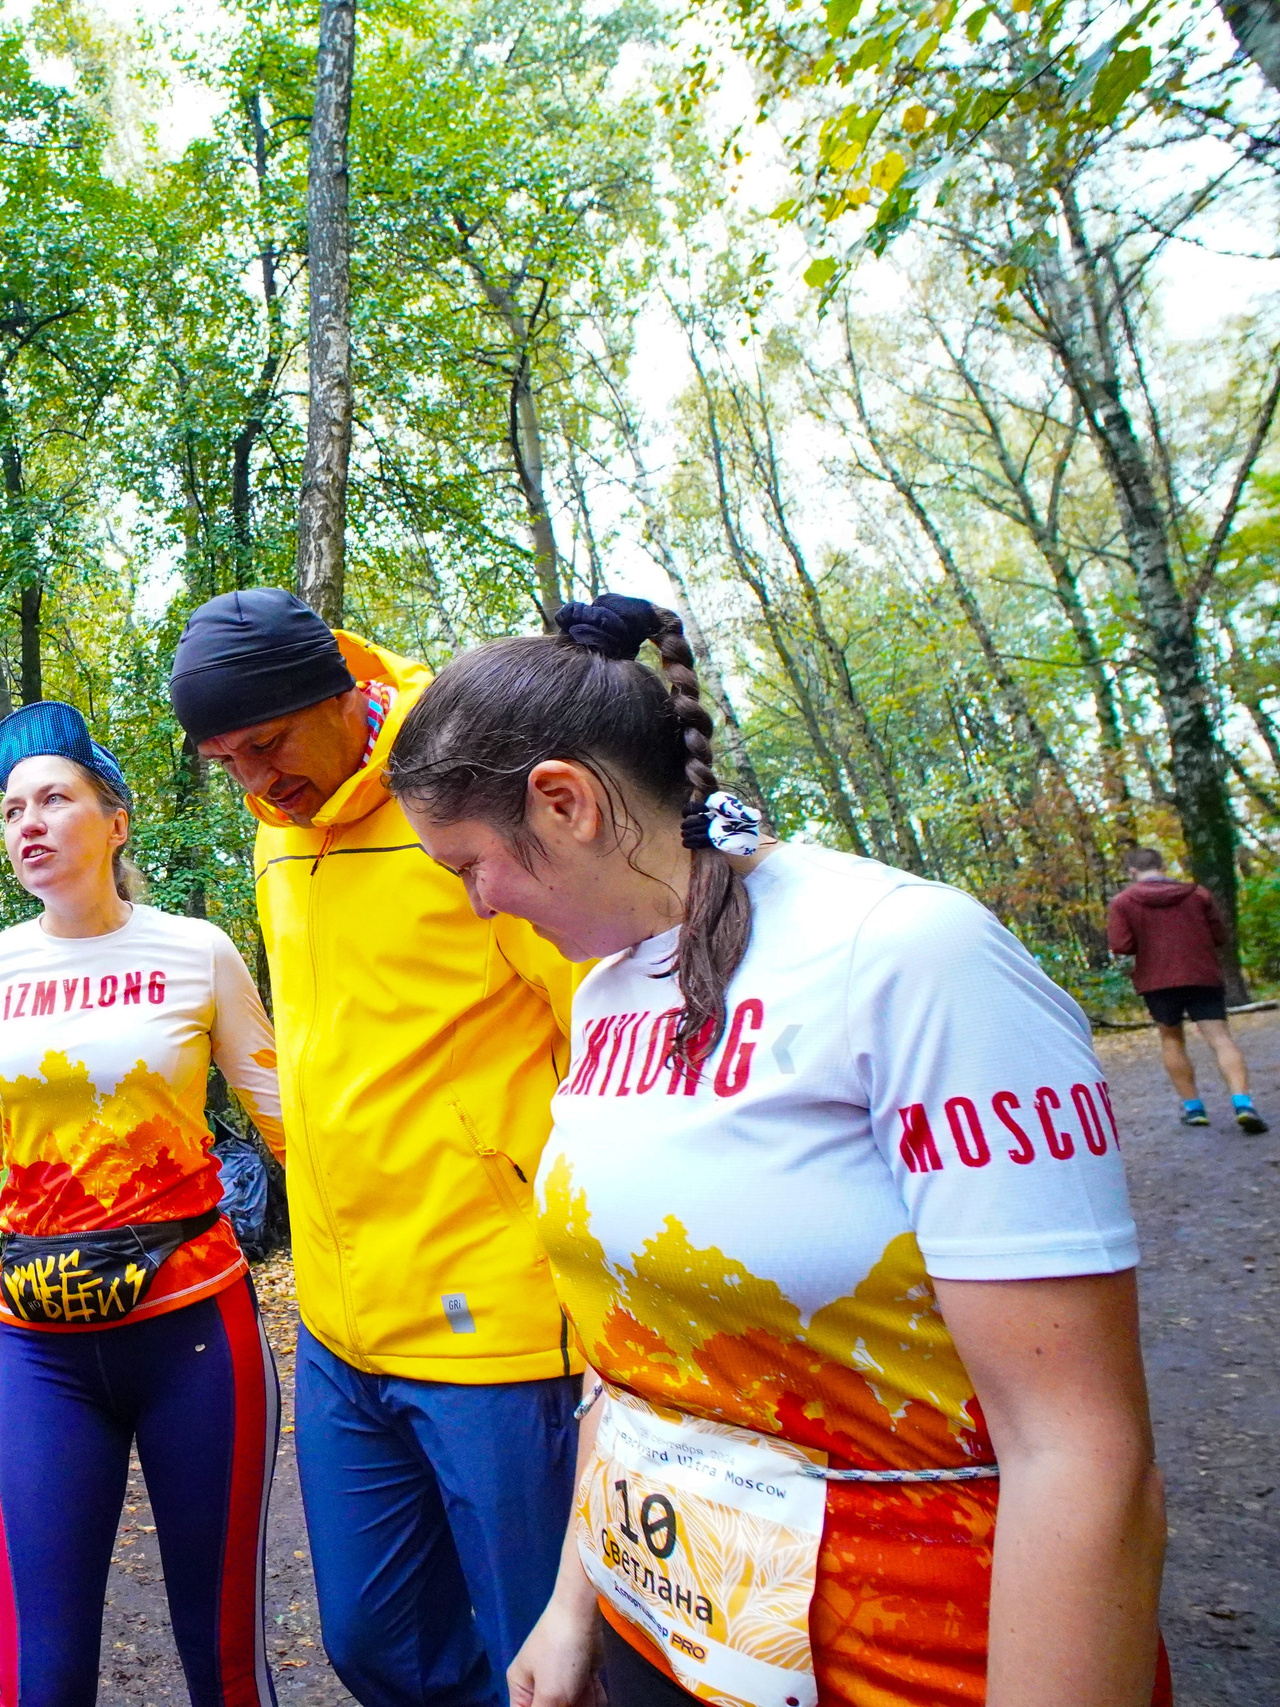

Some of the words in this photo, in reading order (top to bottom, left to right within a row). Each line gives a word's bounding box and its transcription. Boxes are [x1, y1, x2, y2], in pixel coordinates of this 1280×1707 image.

[3, 970, 166, 1021] IZMYLONG
[676, 1454, 717, 1477] Ultra
[724, 1471, 788, 1500] Moscow
[615, 1479, 677, 1560] 10
[671, 1633, 706, 1659] PRO
